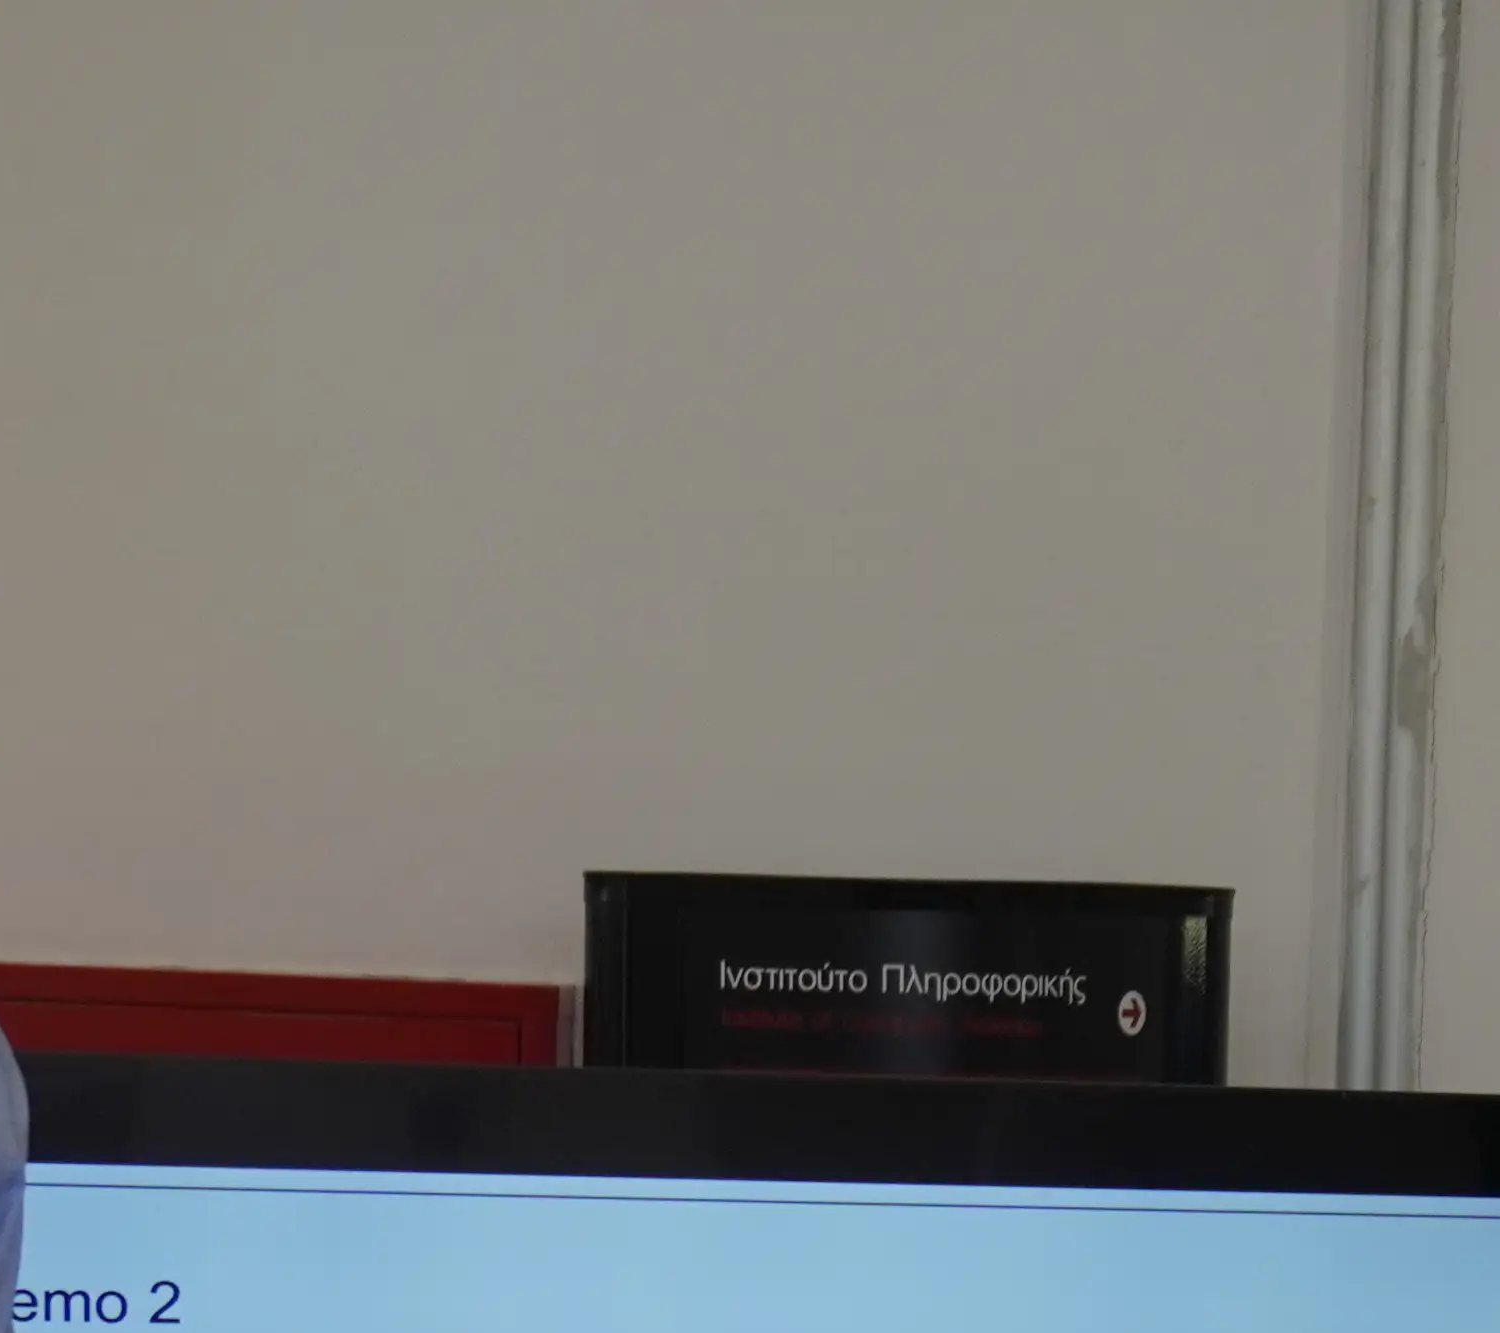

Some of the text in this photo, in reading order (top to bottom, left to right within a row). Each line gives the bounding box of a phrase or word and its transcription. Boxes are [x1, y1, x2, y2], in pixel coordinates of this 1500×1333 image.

[719, 959, 1087, 1006] Ινστιτούτο Πληροφορικής
[12, 1281, 181, 1323] emo 2
